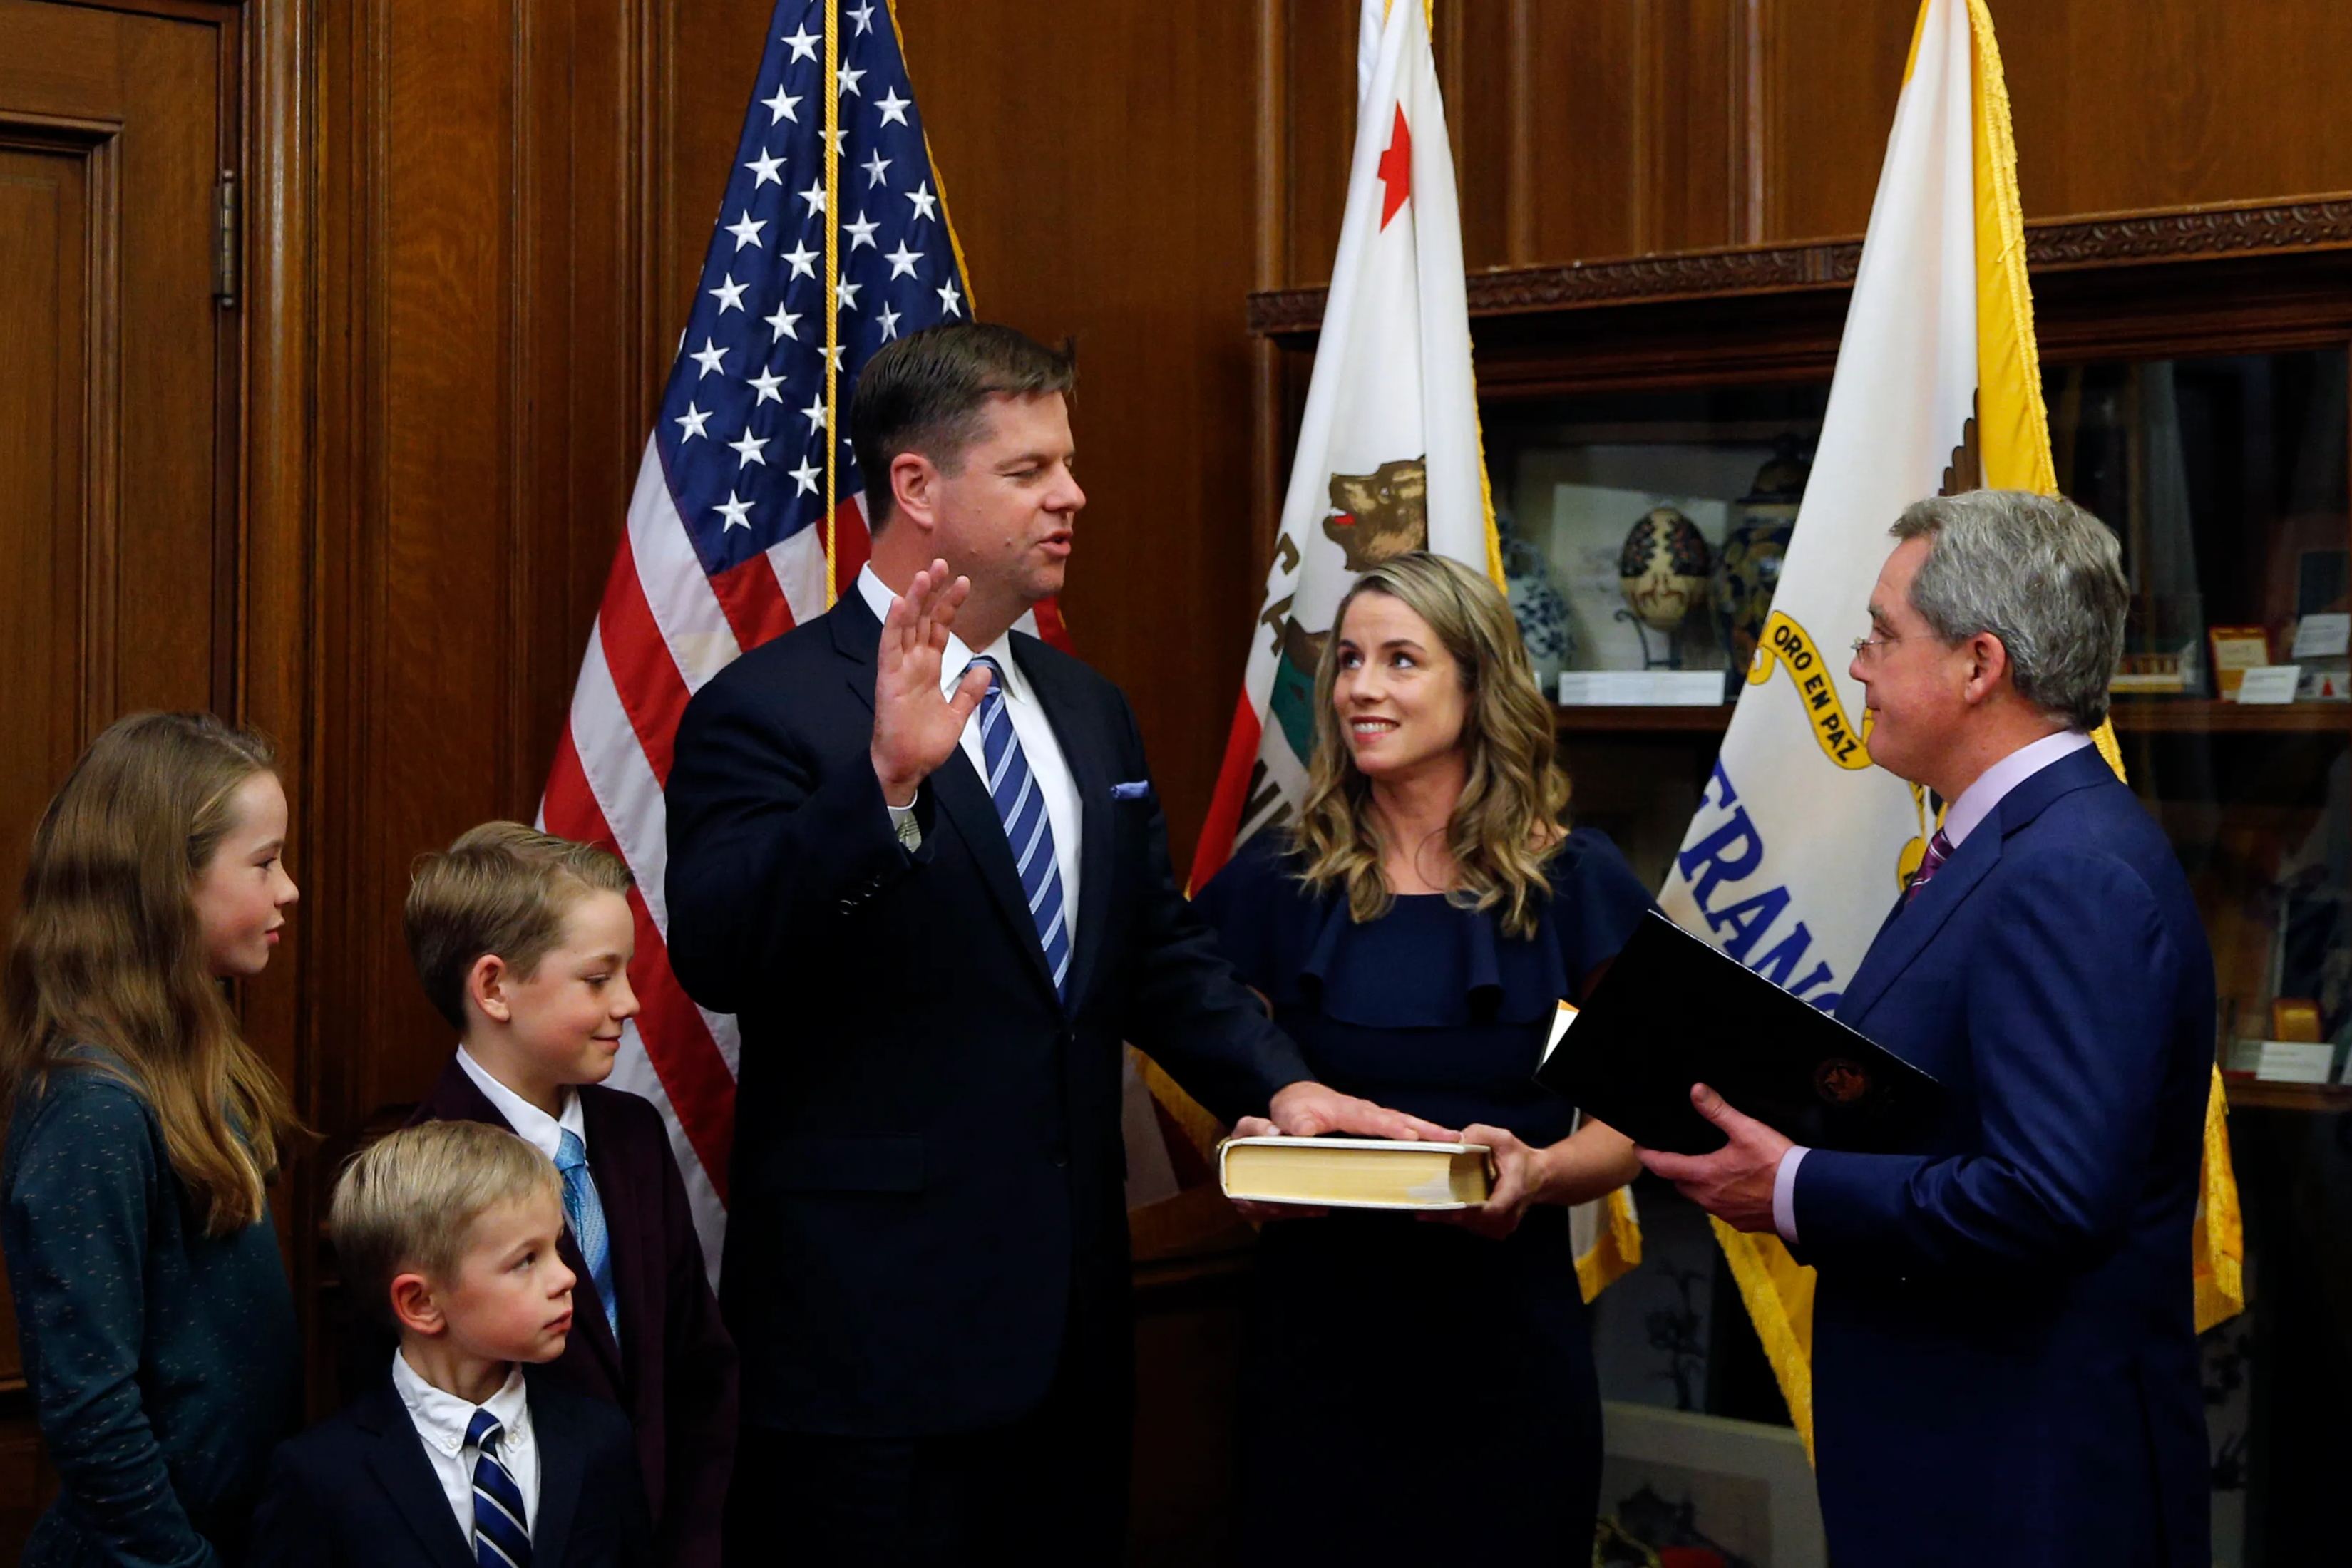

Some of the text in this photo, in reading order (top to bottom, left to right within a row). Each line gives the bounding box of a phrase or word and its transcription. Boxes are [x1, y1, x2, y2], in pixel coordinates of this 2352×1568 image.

[1774, 625, 1857, 763] ORO EN PAZ
